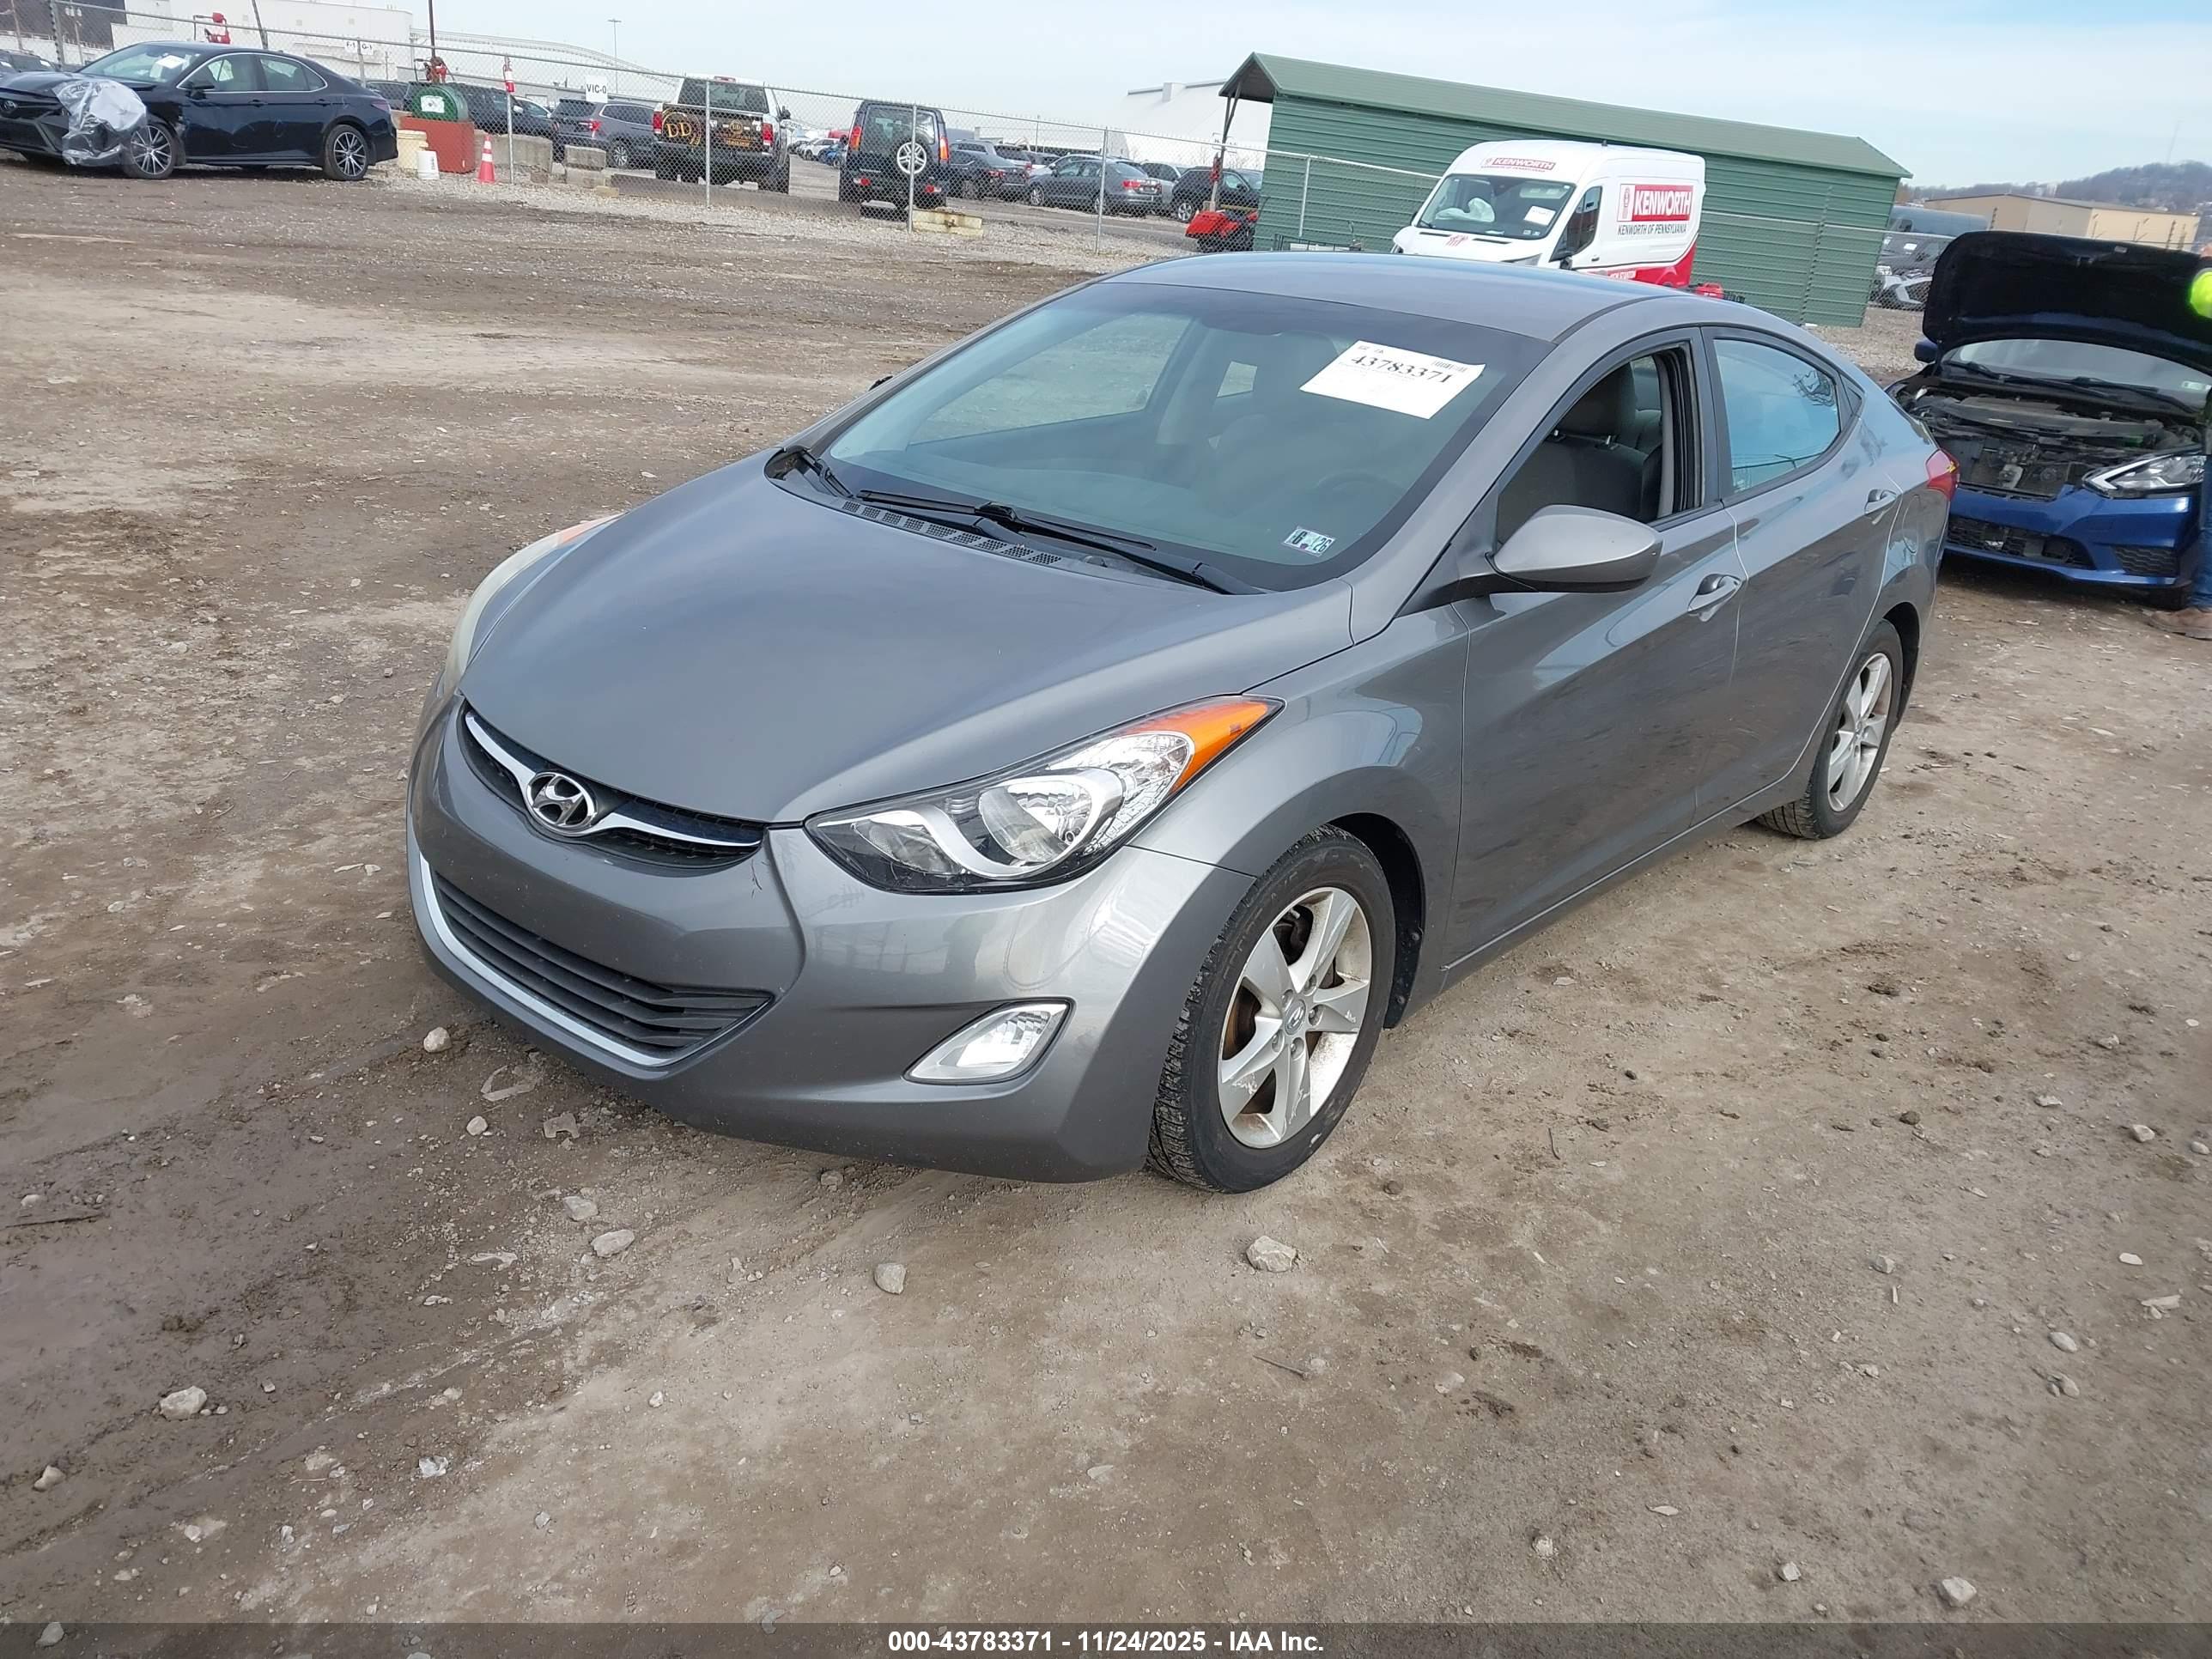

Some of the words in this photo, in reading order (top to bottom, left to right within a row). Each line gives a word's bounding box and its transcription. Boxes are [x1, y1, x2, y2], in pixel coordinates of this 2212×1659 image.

[665, 123, 692, 137] DD
[1494, 157, 1554, 170] KENWORTH
[1633, 190, 1692, 216] KENWORTH
[1618, 224, 1648, 235] KENWORTH
[1648, 224, 1656, 234] OF
[1351, 355, 1454, 383] 43783371
